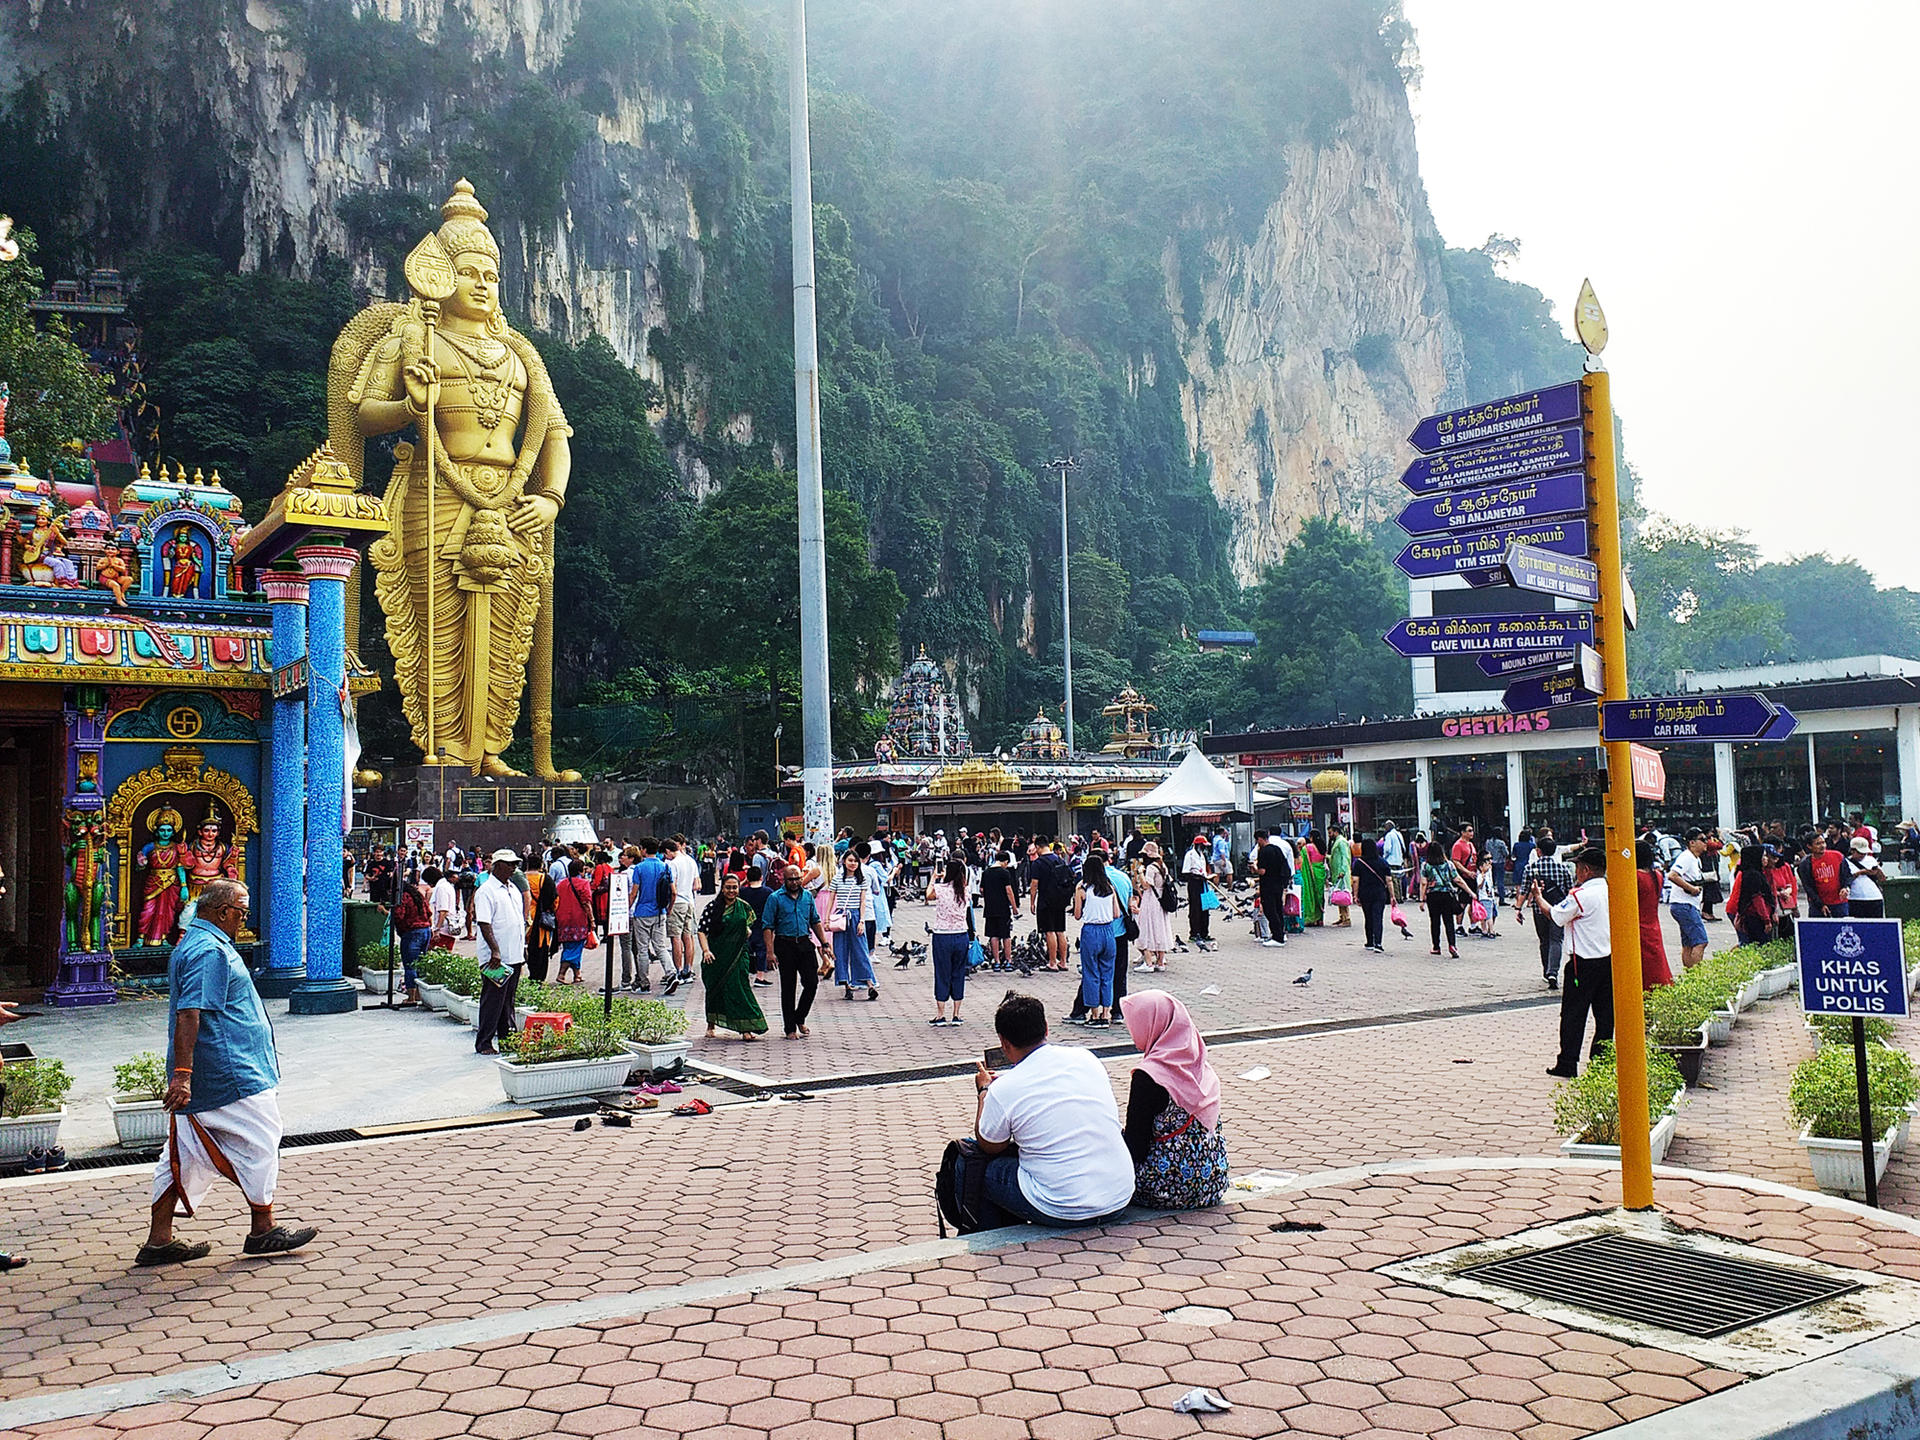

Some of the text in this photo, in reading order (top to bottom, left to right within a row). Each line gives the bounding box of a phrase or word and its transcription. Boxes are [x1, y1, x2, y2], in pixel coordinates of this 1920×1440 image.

[1440, 413, 1544, 446] SRI SUNDHARESWARAR
[1425, 477, 1441, 485] SRI
[1442, 461, 1520, 482] ALARMELMANGA
[1521, 451, 1570, 466] SAMEDHA
[1449, 514, 1466, 527] SRI
[1467, 505, 1526, 524] ANJANEYAR
[1411, 539, 1463, 560] கேடிஎம்
[1467, 533, 1500, 555] ரயில்
[1455, 556, 1477, 569] KTM
[1489, 570, 1502, 582] SRI
[1406, 622, 1440, 637] கேவ்
[1444, 619, 1490, 636] வில்லா
[1431, 635, 1564, 651] CAVE VILLA ART GALLERY
[1501, 657, 1527, 671] MOUNA
[1527, 652, 1555, 666] SWAMY
[1551, 692, 1572, 704] TOILET
[1629, 703, 1652, 720] கார்
[1442, 711, 1551, 737] GEETHA'S
[1654, 723, 1698, 736] CAR PARK
[1634, 757, 1660, 788] TOILET
[1821, 960, 1880, 975] KHAS
[1815, 977, 1889, 994] UNTUK
[1822, 996, 1885, 1012] POLIS
